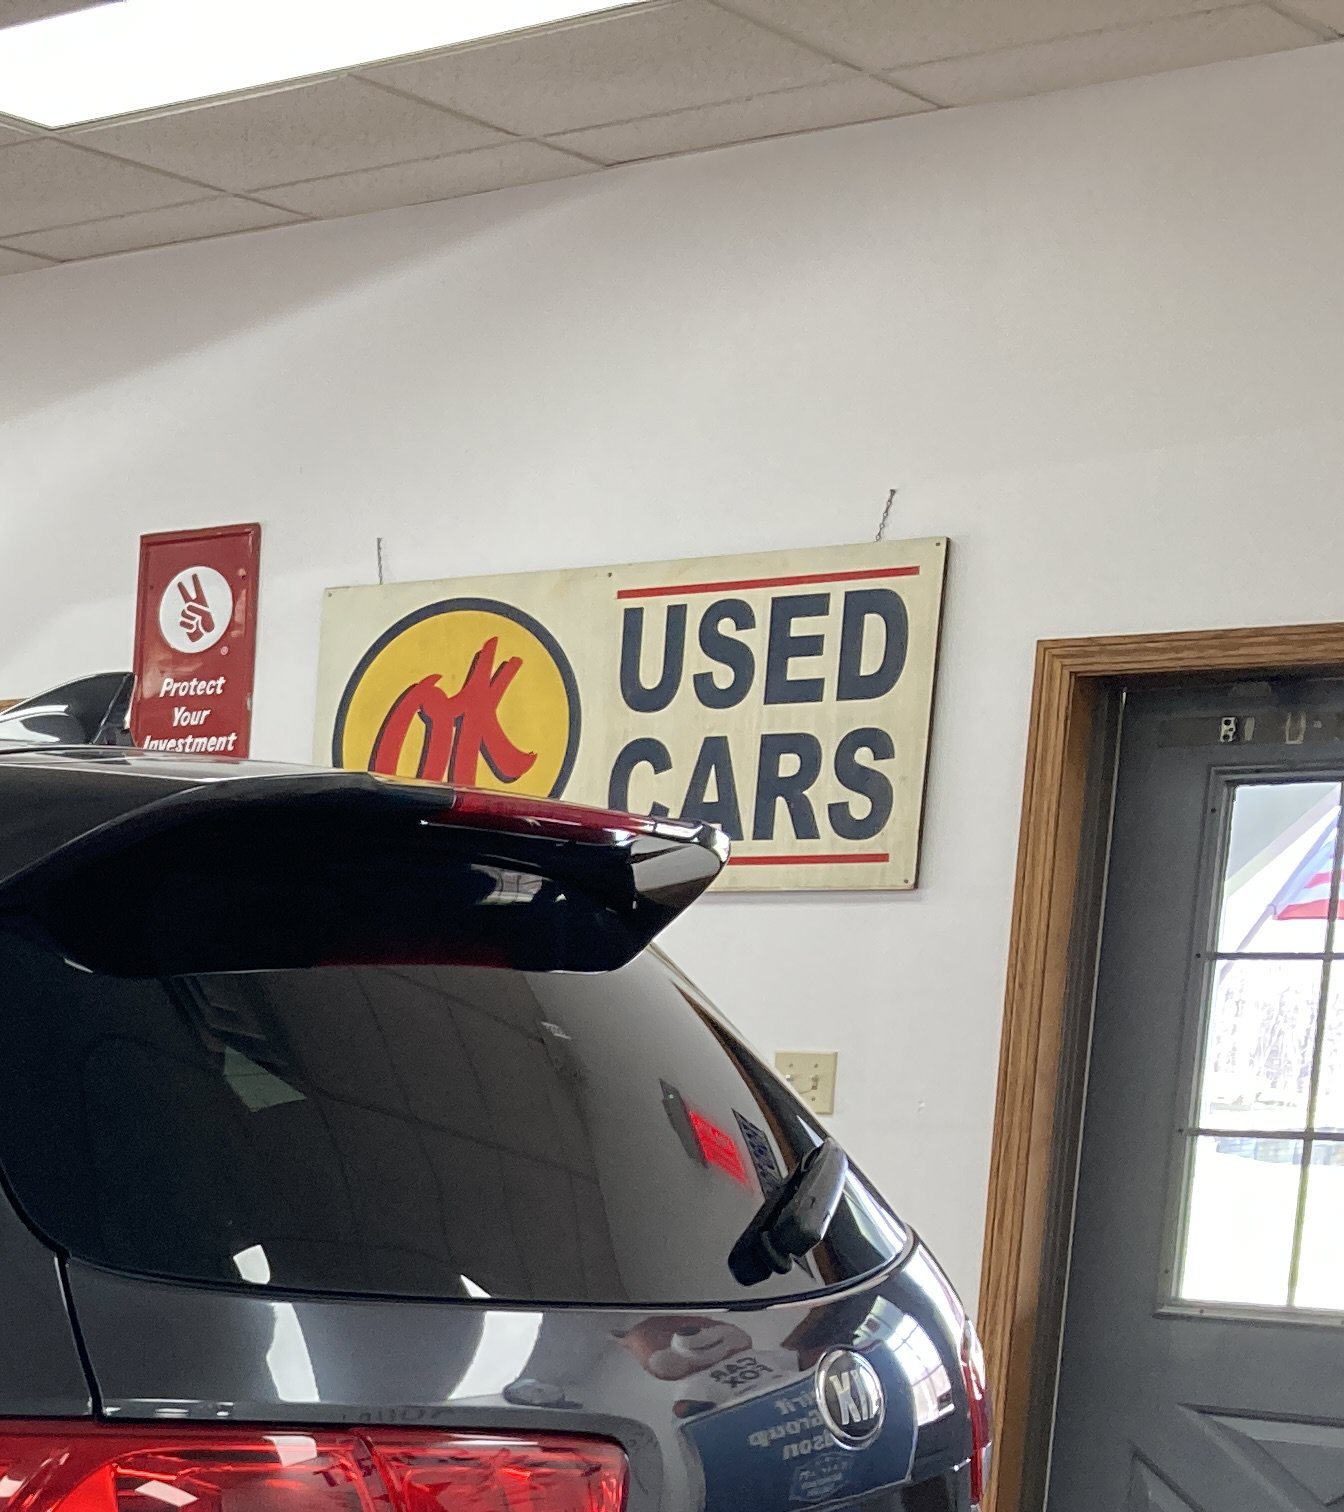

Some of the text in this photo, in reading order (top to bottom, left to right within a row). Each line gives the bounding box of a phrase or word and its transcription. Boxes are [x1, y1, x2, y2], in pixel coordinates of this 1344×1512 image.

[619, 588, 909, 713] USED
[159, 676, 226, 697] Protect
[367, 636, 538, 786] OK
[143, 732, 237, 752] Investment
[172, 706, 211, 727] Your
[608, 727, 895, 841] CARS
[829, 1368, 876, 1425] KI
